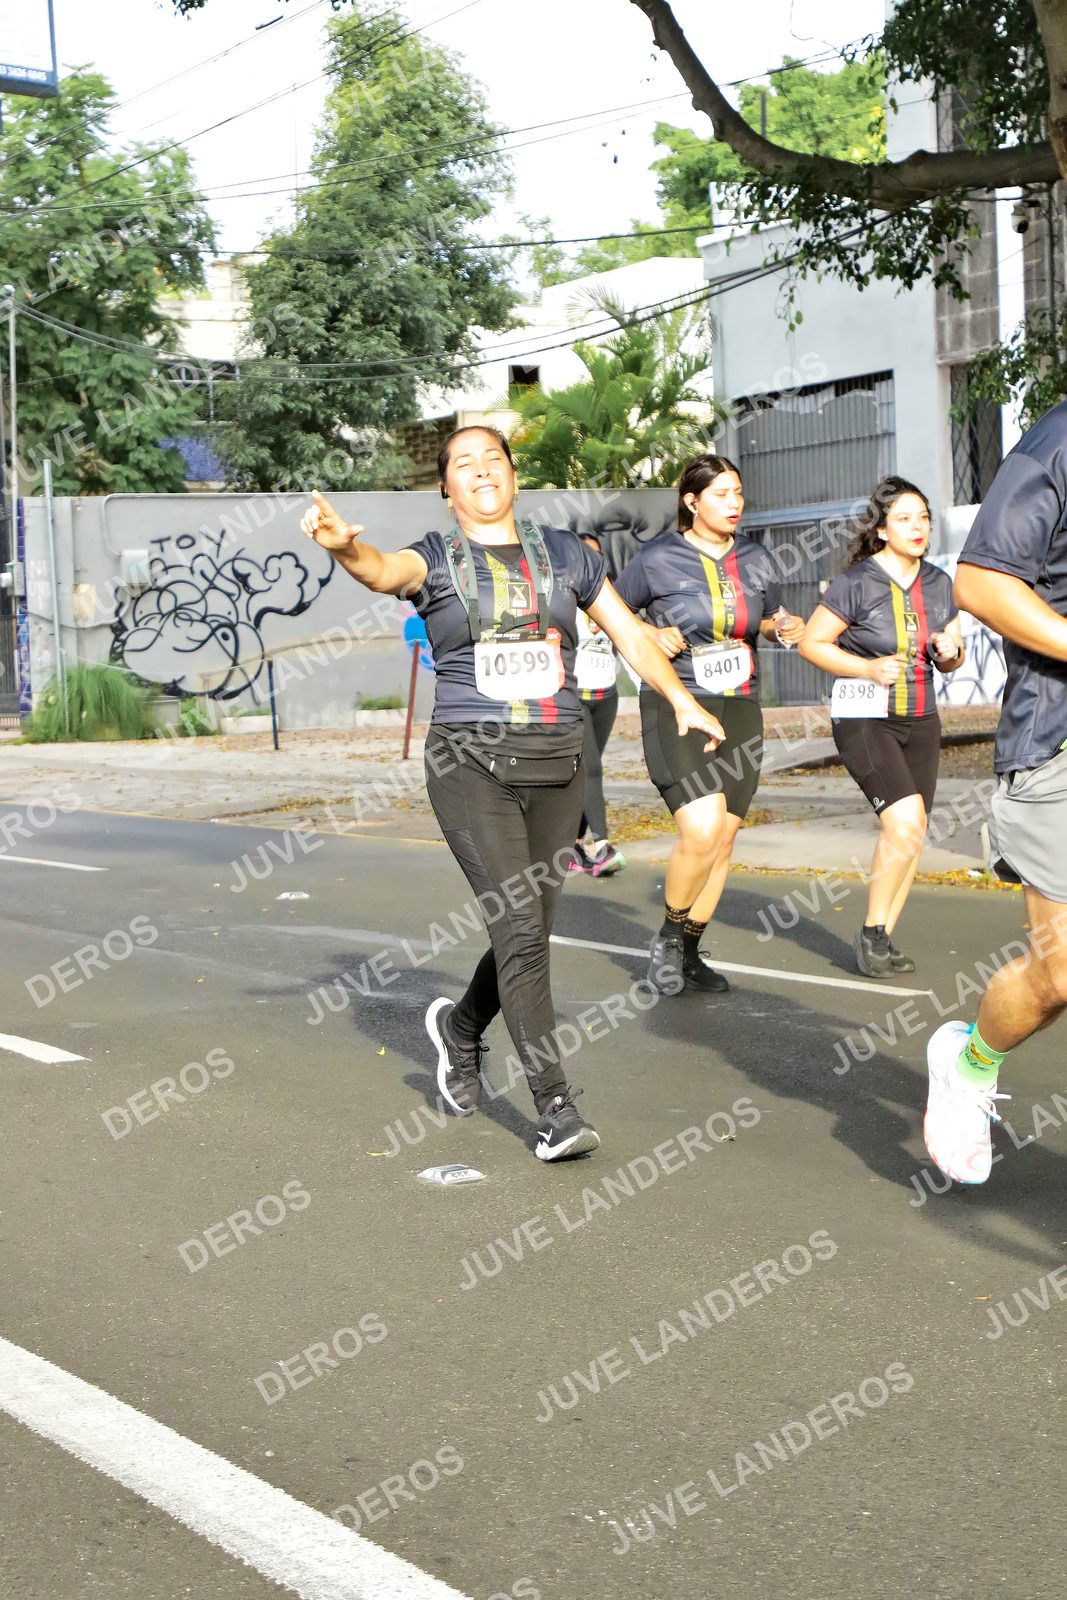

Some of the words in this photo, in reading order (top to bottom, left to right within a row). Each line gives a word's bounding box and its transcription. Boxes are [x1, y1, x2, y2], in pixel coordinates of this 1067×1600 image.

[150, 529, 226, 558] TOY
[480, 650, 551, 677] 10599
[703, 656, 741, 678] 8401
[838, 683, 876, 699] 8398
